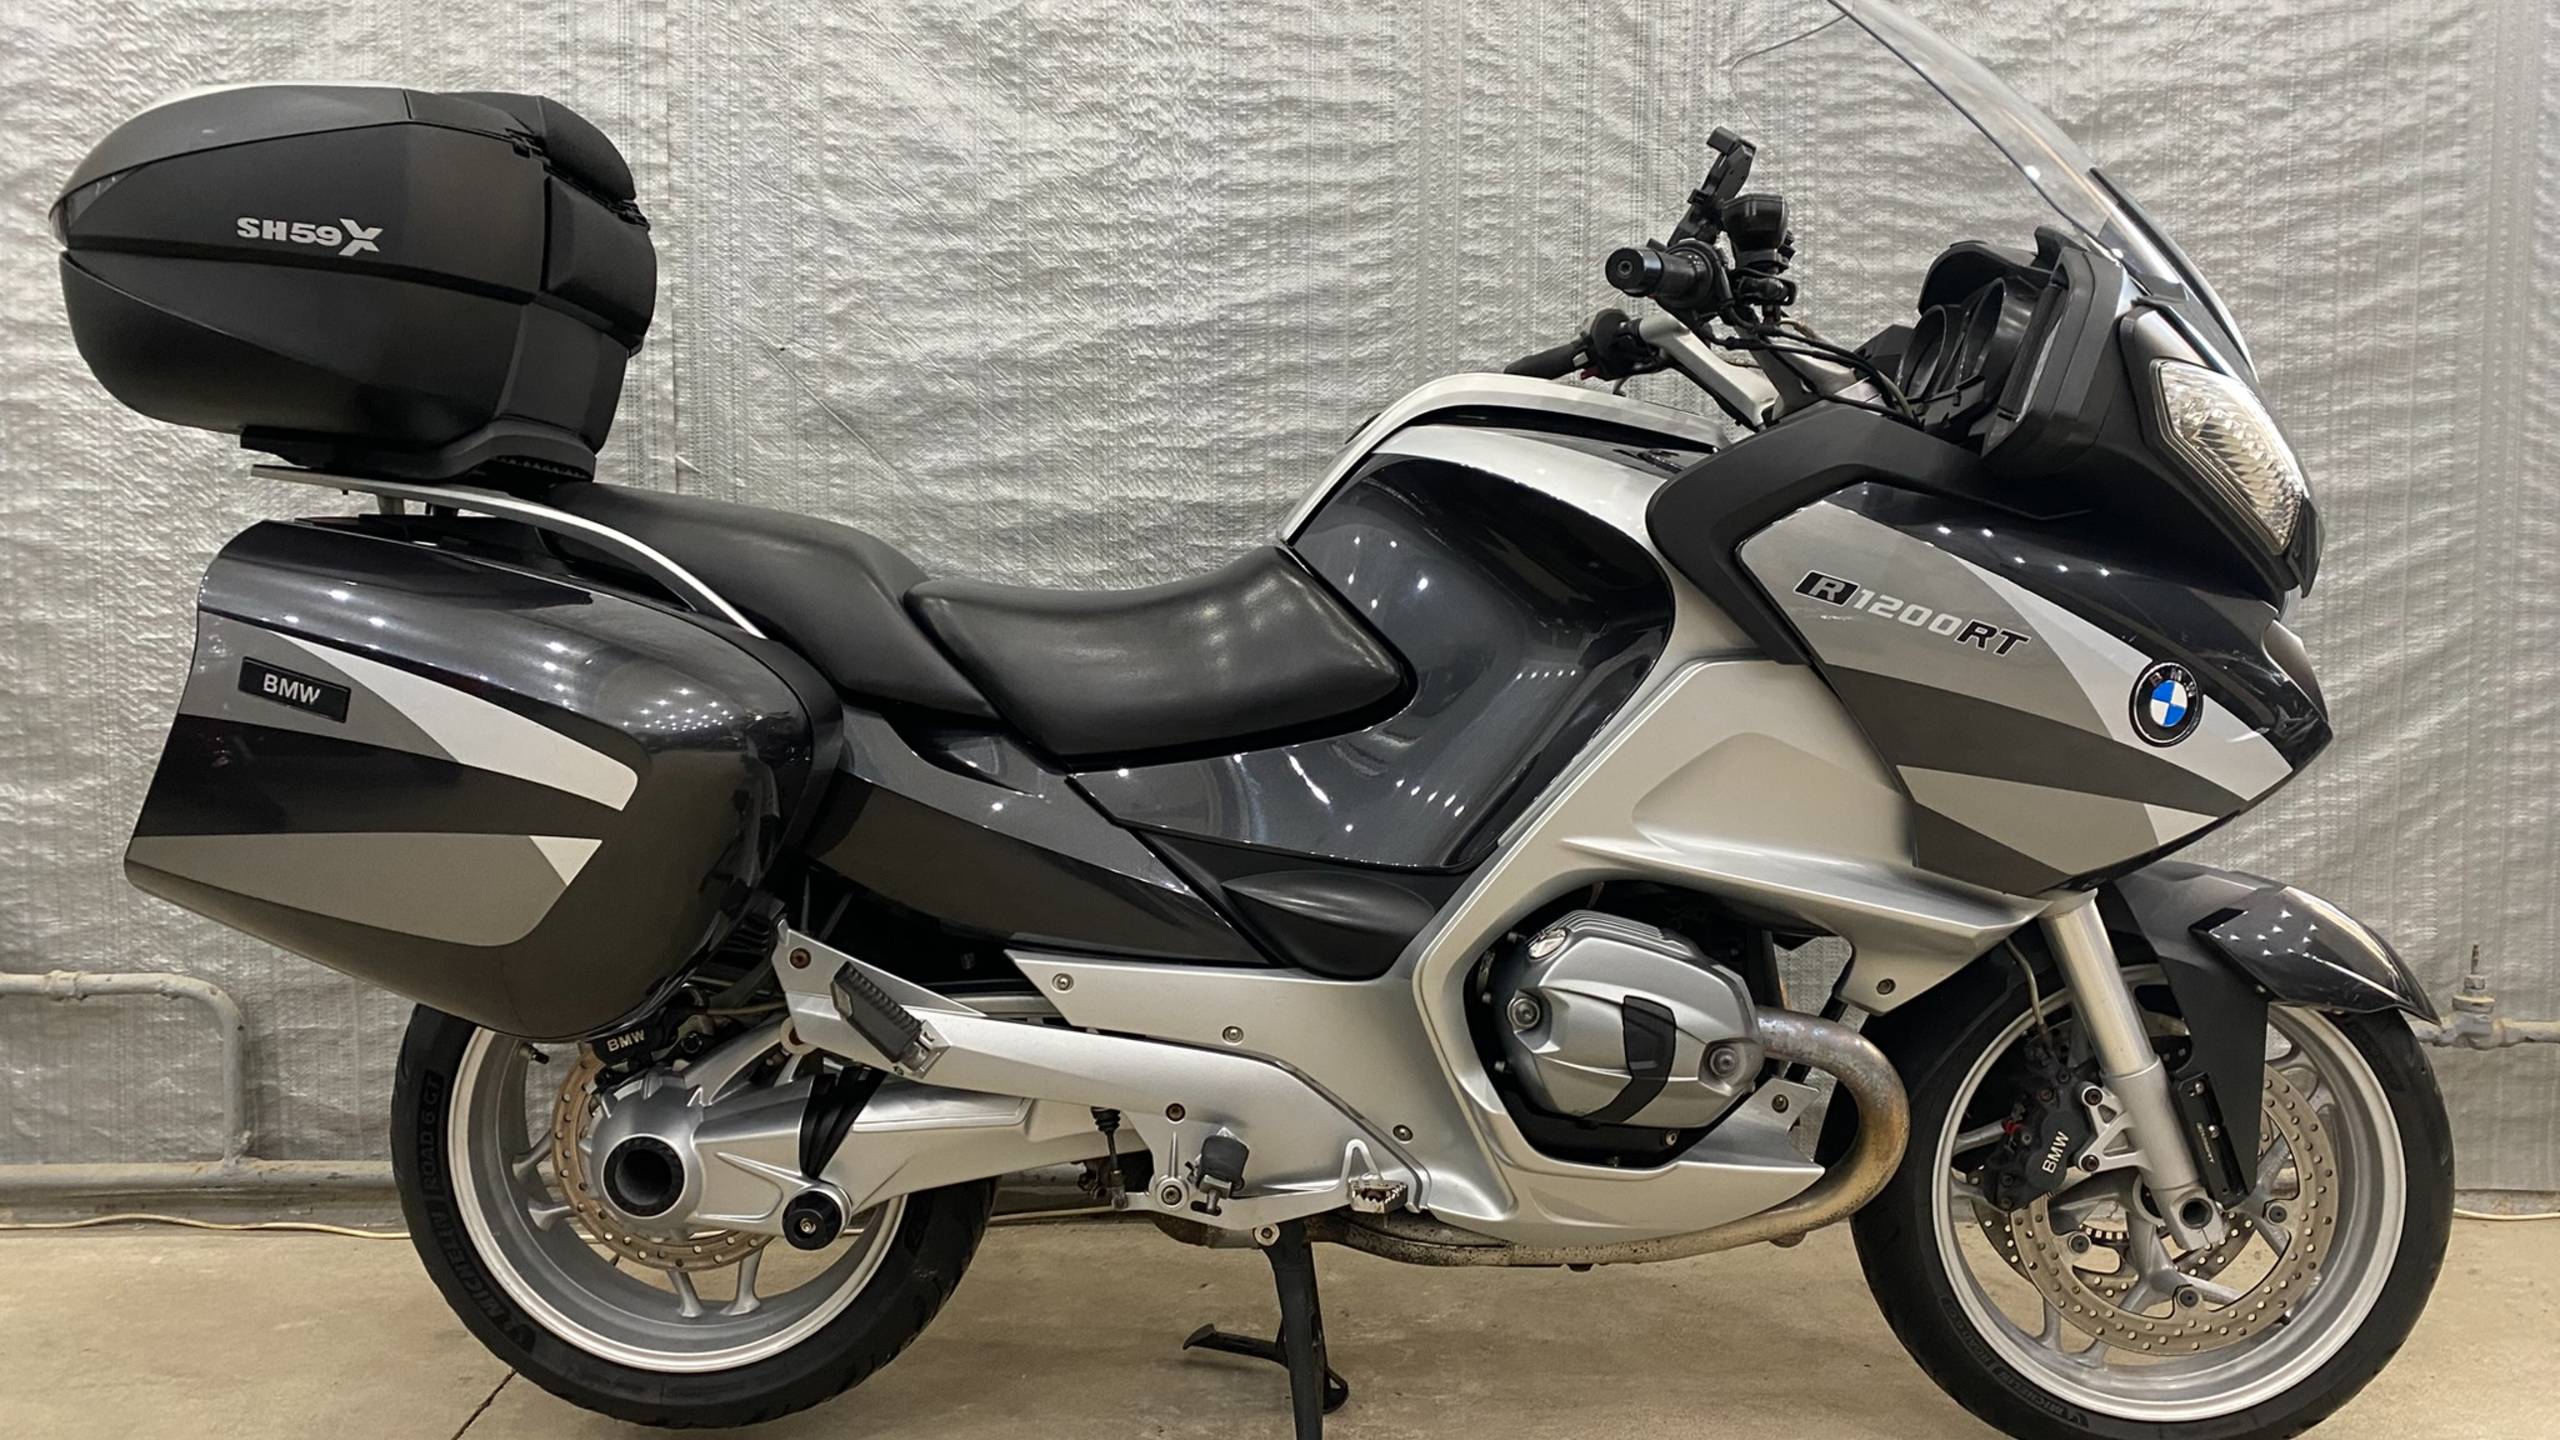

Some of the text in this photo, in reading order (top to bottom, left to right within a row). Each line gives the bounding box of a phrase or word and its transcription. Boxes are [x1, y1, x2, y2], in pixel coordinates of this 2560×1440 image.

[236, 216, 384, 257] SH59X
[1805, 573, 2031, 657] R1200RT
[262, 672, 321, 705] BMW
[2149, 666, 2197, 698] BMW
[605, 1029, 646, 1053] BMW
[2041, 1130, 2070, 1175] BMW
[419, 1078, 504, 1321] MICHELIN ROAD 6 GT
[1998, 1370, 2066, 1416] MICHELIN
